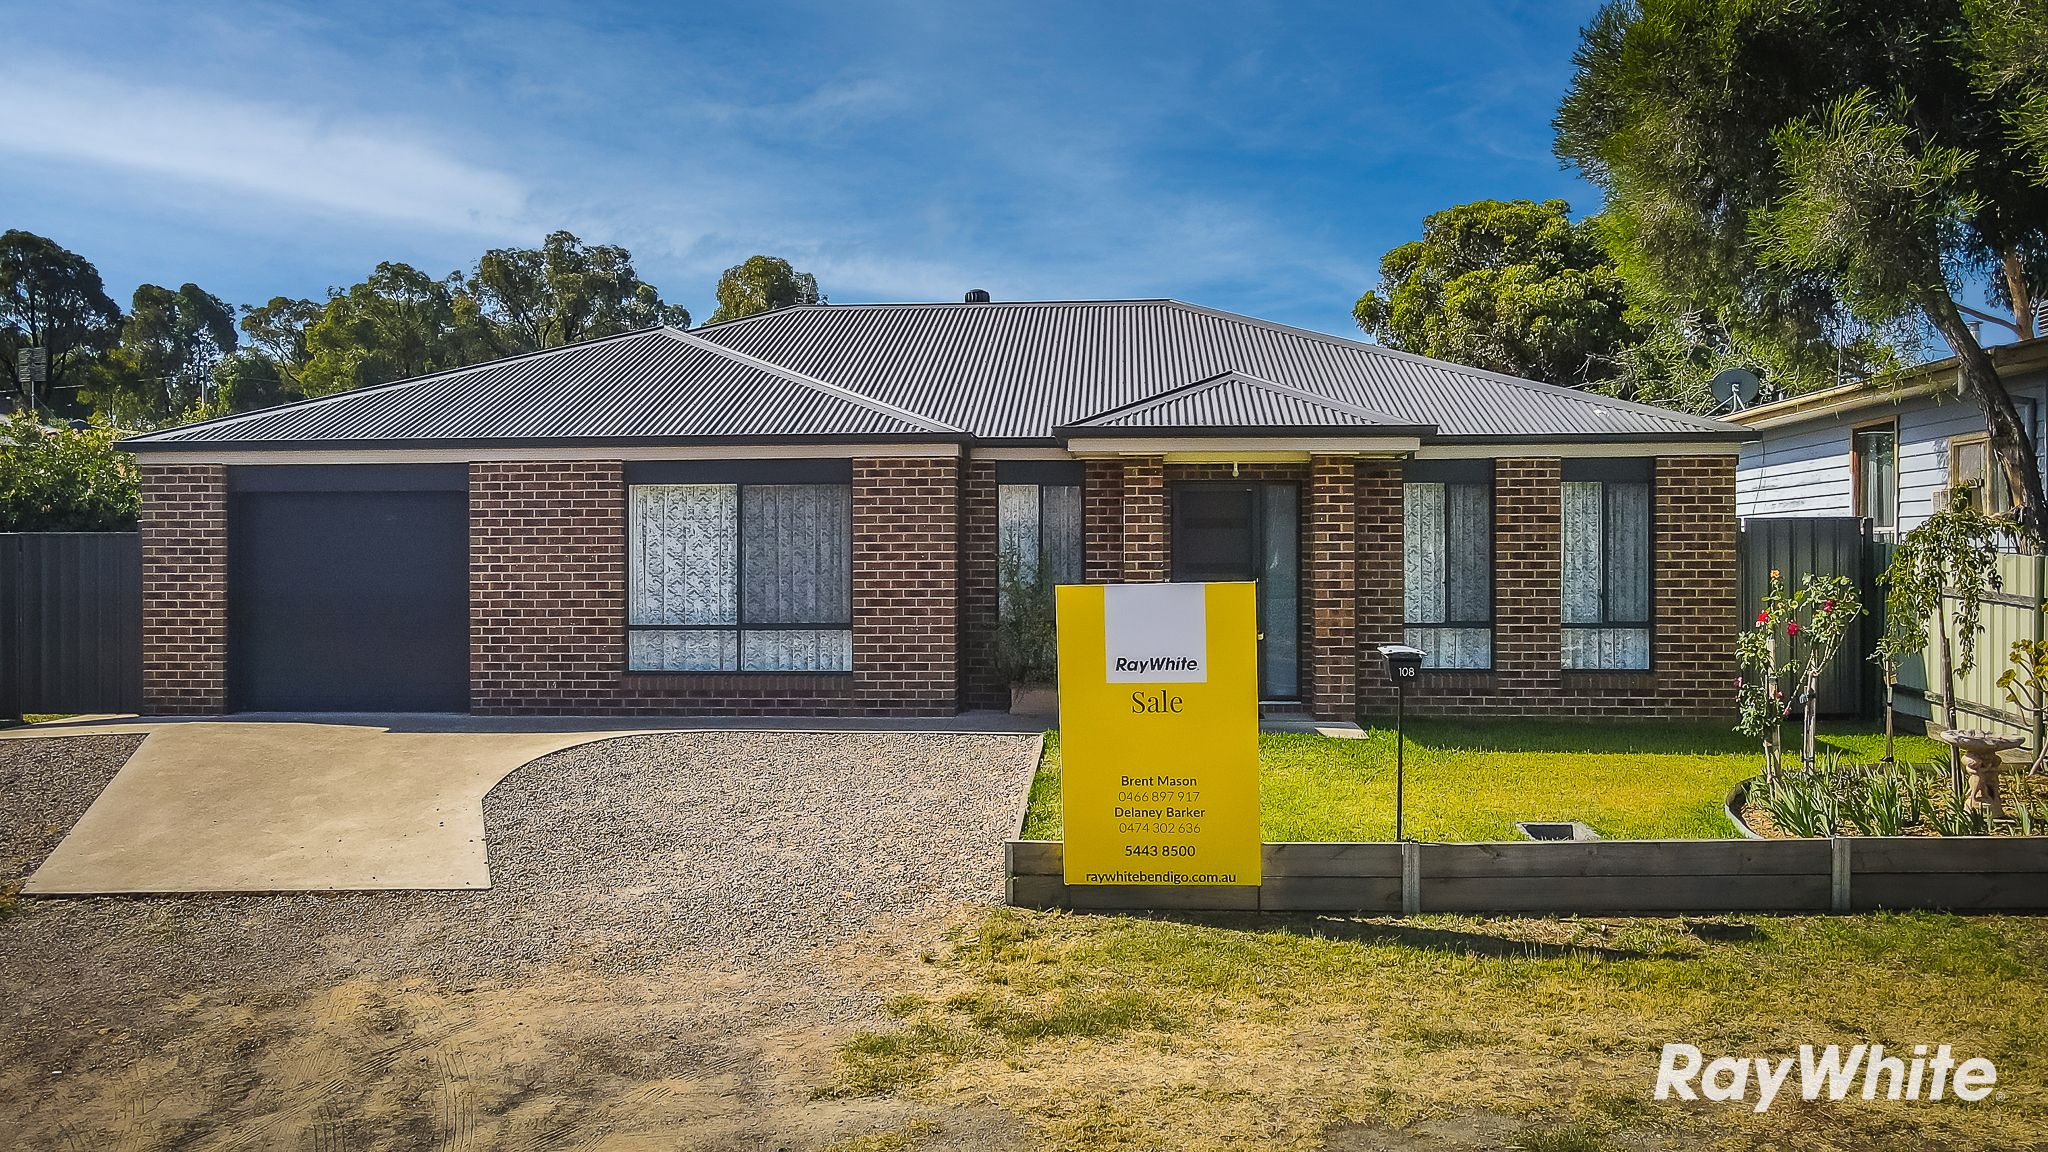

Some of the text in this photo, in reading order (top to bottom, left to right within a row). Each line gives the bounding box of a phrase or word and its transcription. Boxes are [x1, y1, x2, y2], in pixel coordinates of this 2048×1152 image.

[1398, 667, 1415, 677] 108
[1131, 690, 1184, 714] Sale
[1121, 775, 1197, 786] Brent Mason
[1118, 792, 1200, 802] 0466 897 917
[1114, 807, 1205, 820] Delaney Barker
[1119, 823, 1201, 833] 0474 302 636
[1125, 845, 1195, 857] 5443 8500
[1086, 871, 1237, 884] raywhitebendigo.com.au
